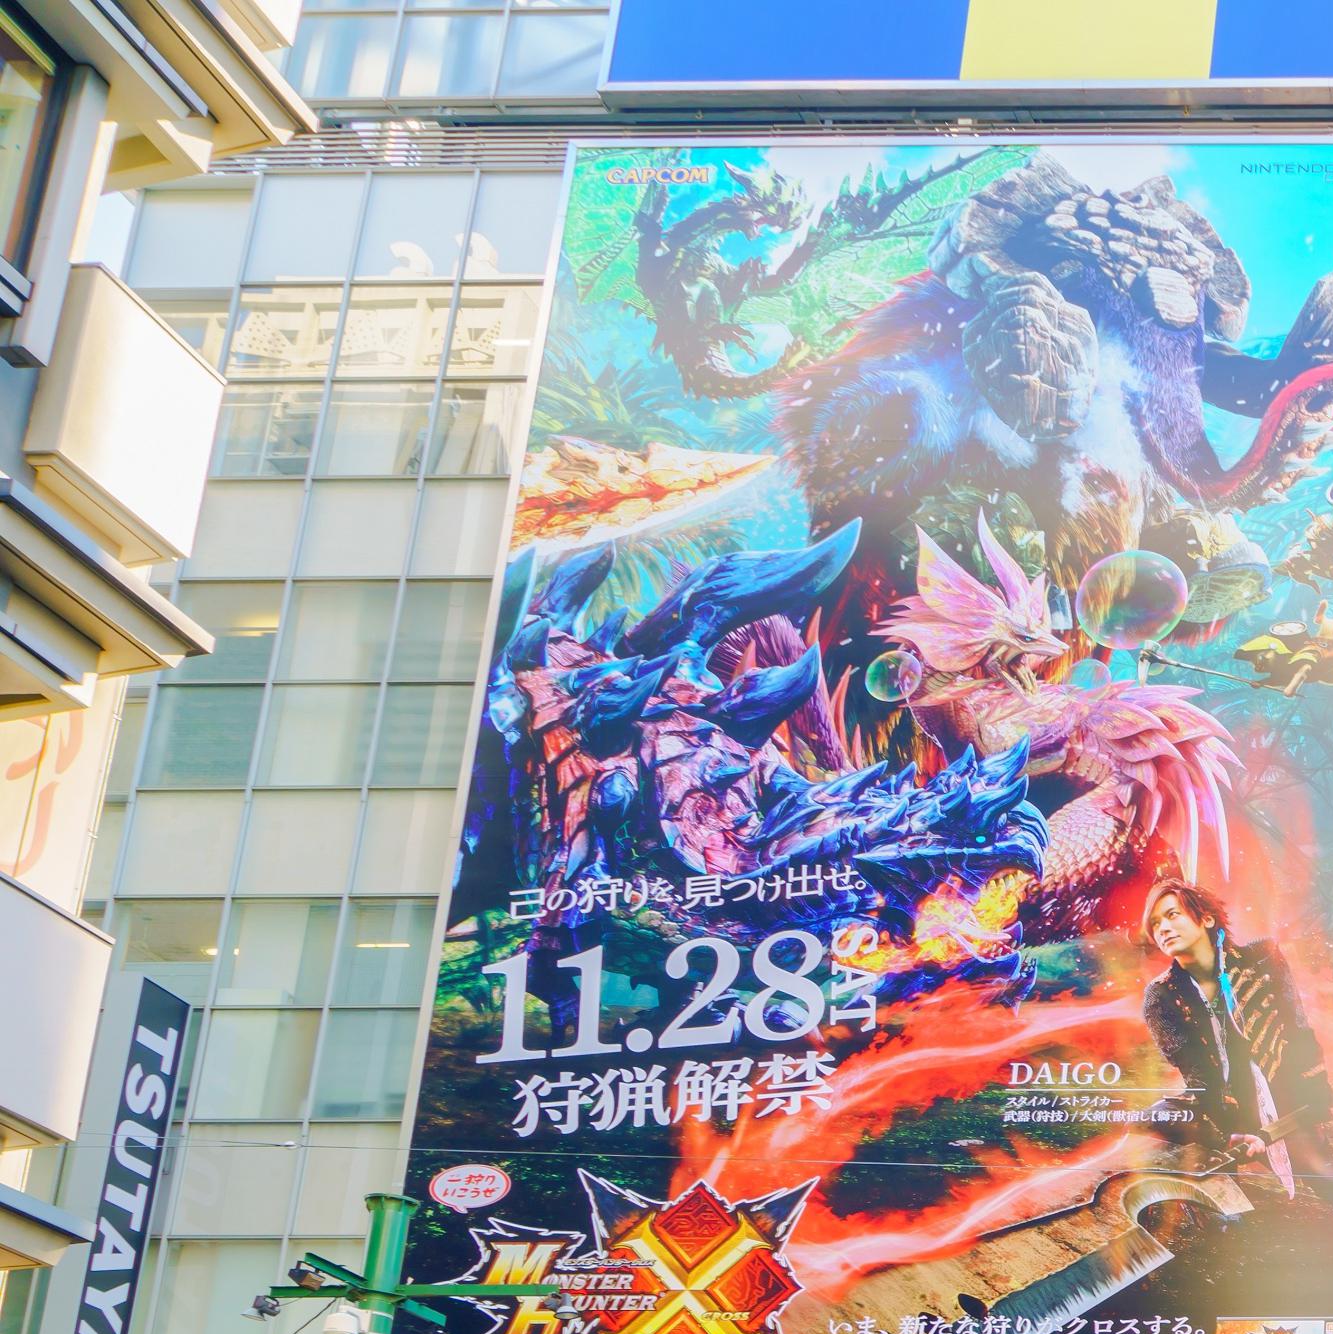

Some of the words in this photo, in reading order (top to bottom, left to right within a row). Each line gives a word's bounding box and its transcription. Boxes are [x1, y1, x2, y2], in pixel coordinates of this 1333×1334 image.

[606, 165, 712, 186] CAPCOM
[508, 867, 869, 921] 己の狩りを、見つけ出せ。
[475, 929, 828, 1066] 11.28
[829, 926, 878, 1034] SAT
[511, 1052, 839, 1139] 狩猟解禁
[1008, 1061, 1122, 1086] DAIGO
[448, 1174, 497, 1186] 一狩り
[485, 1241, 634, 1290] MONSTER
[701, 1309, 752, 1323] CROSS
